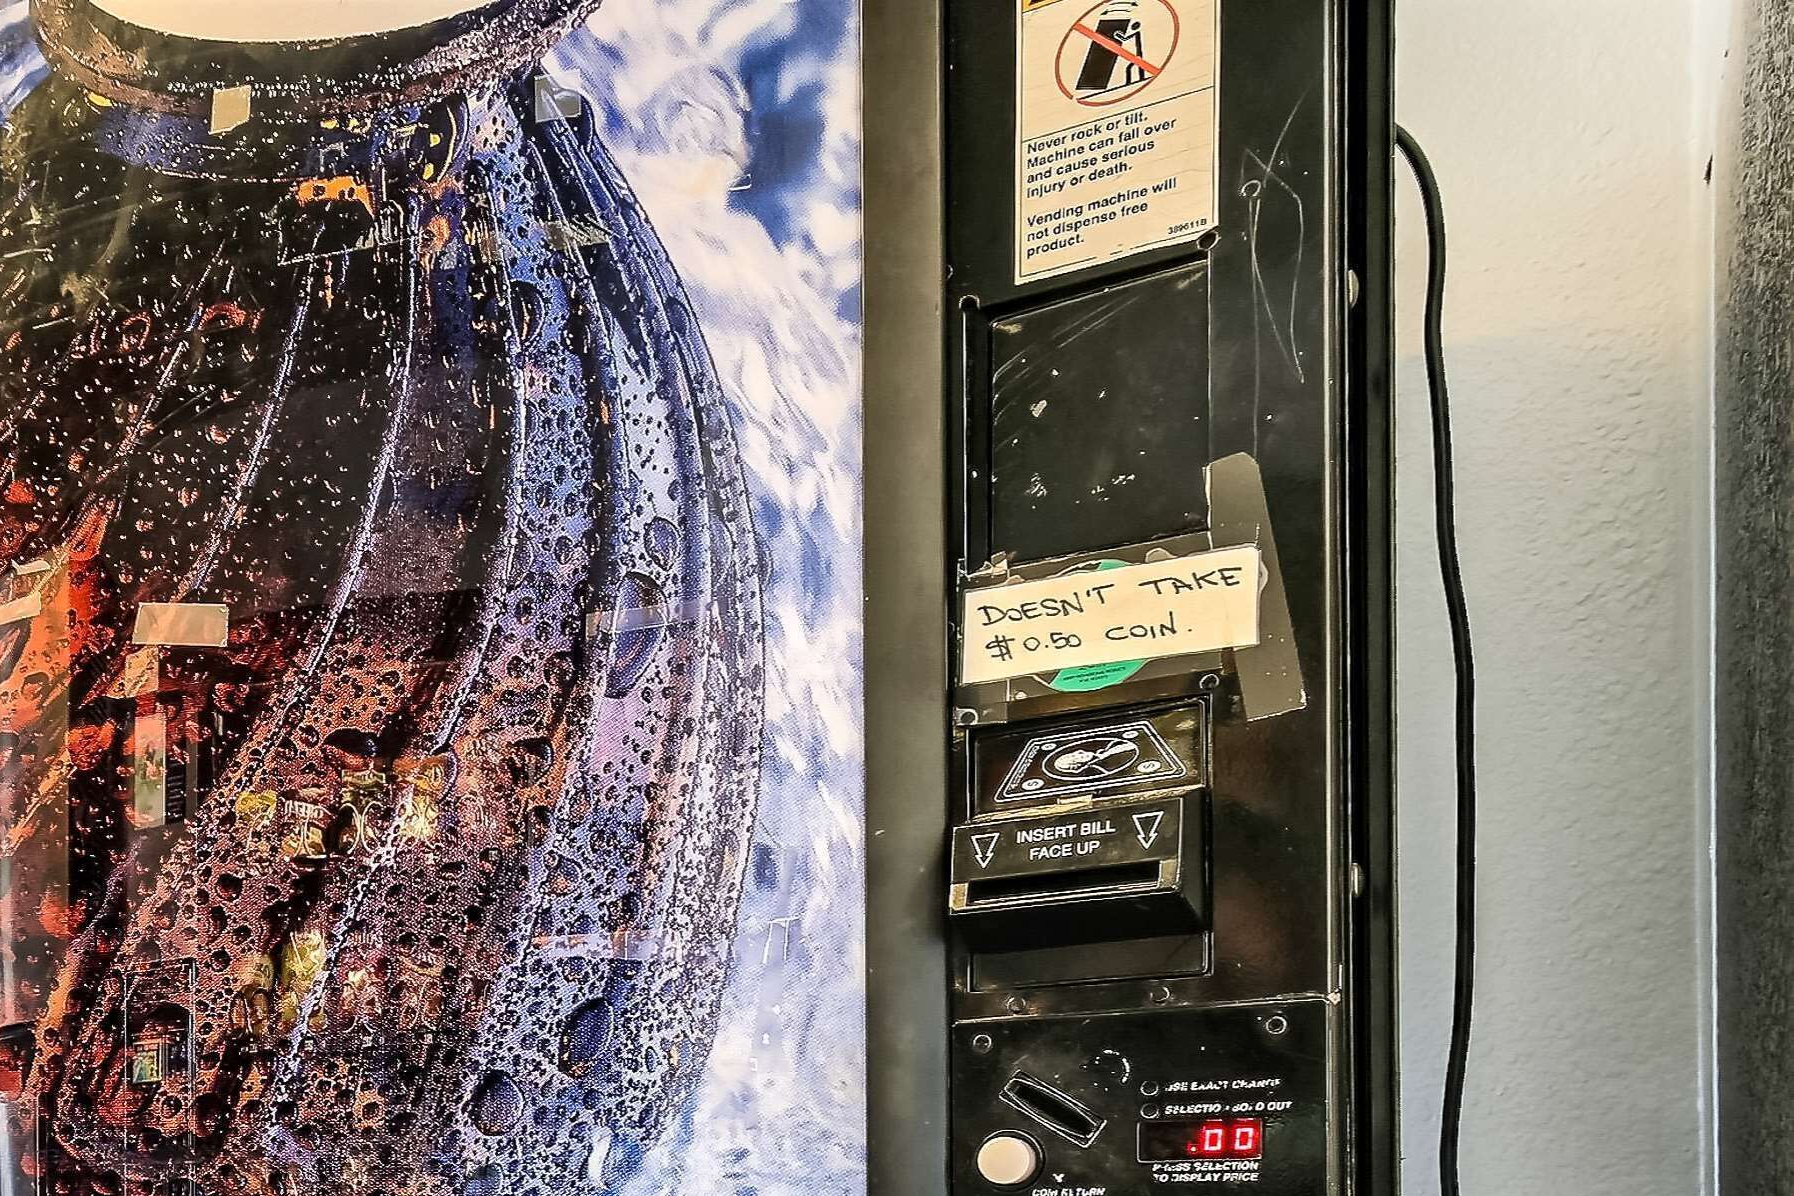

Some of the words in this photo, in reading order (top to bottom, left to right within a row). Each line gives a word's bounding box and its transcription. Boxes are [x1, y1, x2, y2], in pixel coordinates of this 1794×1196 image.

[1027, 135, 1067, 154] Never
[1071, 125, 1102, 141] rock
[1106, 119, 1121, 131] or
[1125, 111, 1148, 126] tilt.
[1027, 144, 1086, 169] Machine
[1089, 137, 1114, 151] can
[1118, 127, 1140, 143] fall
[1144, 118, 1177, 135] over
[1027, 167, 1052, 184] and
[1056, 156, 1097, 176] cause
[1101, 141, 1155, 163] serious
[1027, 178, 1066, 199] injury
[1070, 174, 1084, 187] or
[1088, 161, 1133, 181] death.
[1027, 205, 1083, 227] Vending
[1087, 186, 1148, 211] machine
[1152, 178, 1177, 194] will
[1027, 226, 1049, 243] not
[1053, 210, 1117, 237] dispense
[1121, 202, 1148, 218] free
[1027, 235, 1084, 259] product.
[977, 583, 1116, 626] DOESN'T
[1138, 566, 1242, 597] TAKE
[985, 631, 1081, 662] $0.50
[1016, 823, 1075, 845] INSERT
[1080, 819, 1116, 839] BILL
[1029, 843, 1073, 862] FACE
[1078, 840, 1100, 857] UP
[1267, 1101, 1293, 1112] OUT
[1194, 1161, 1259, 1172] SELECTION
[1222, 1172, 1259, 1183] PRICE
